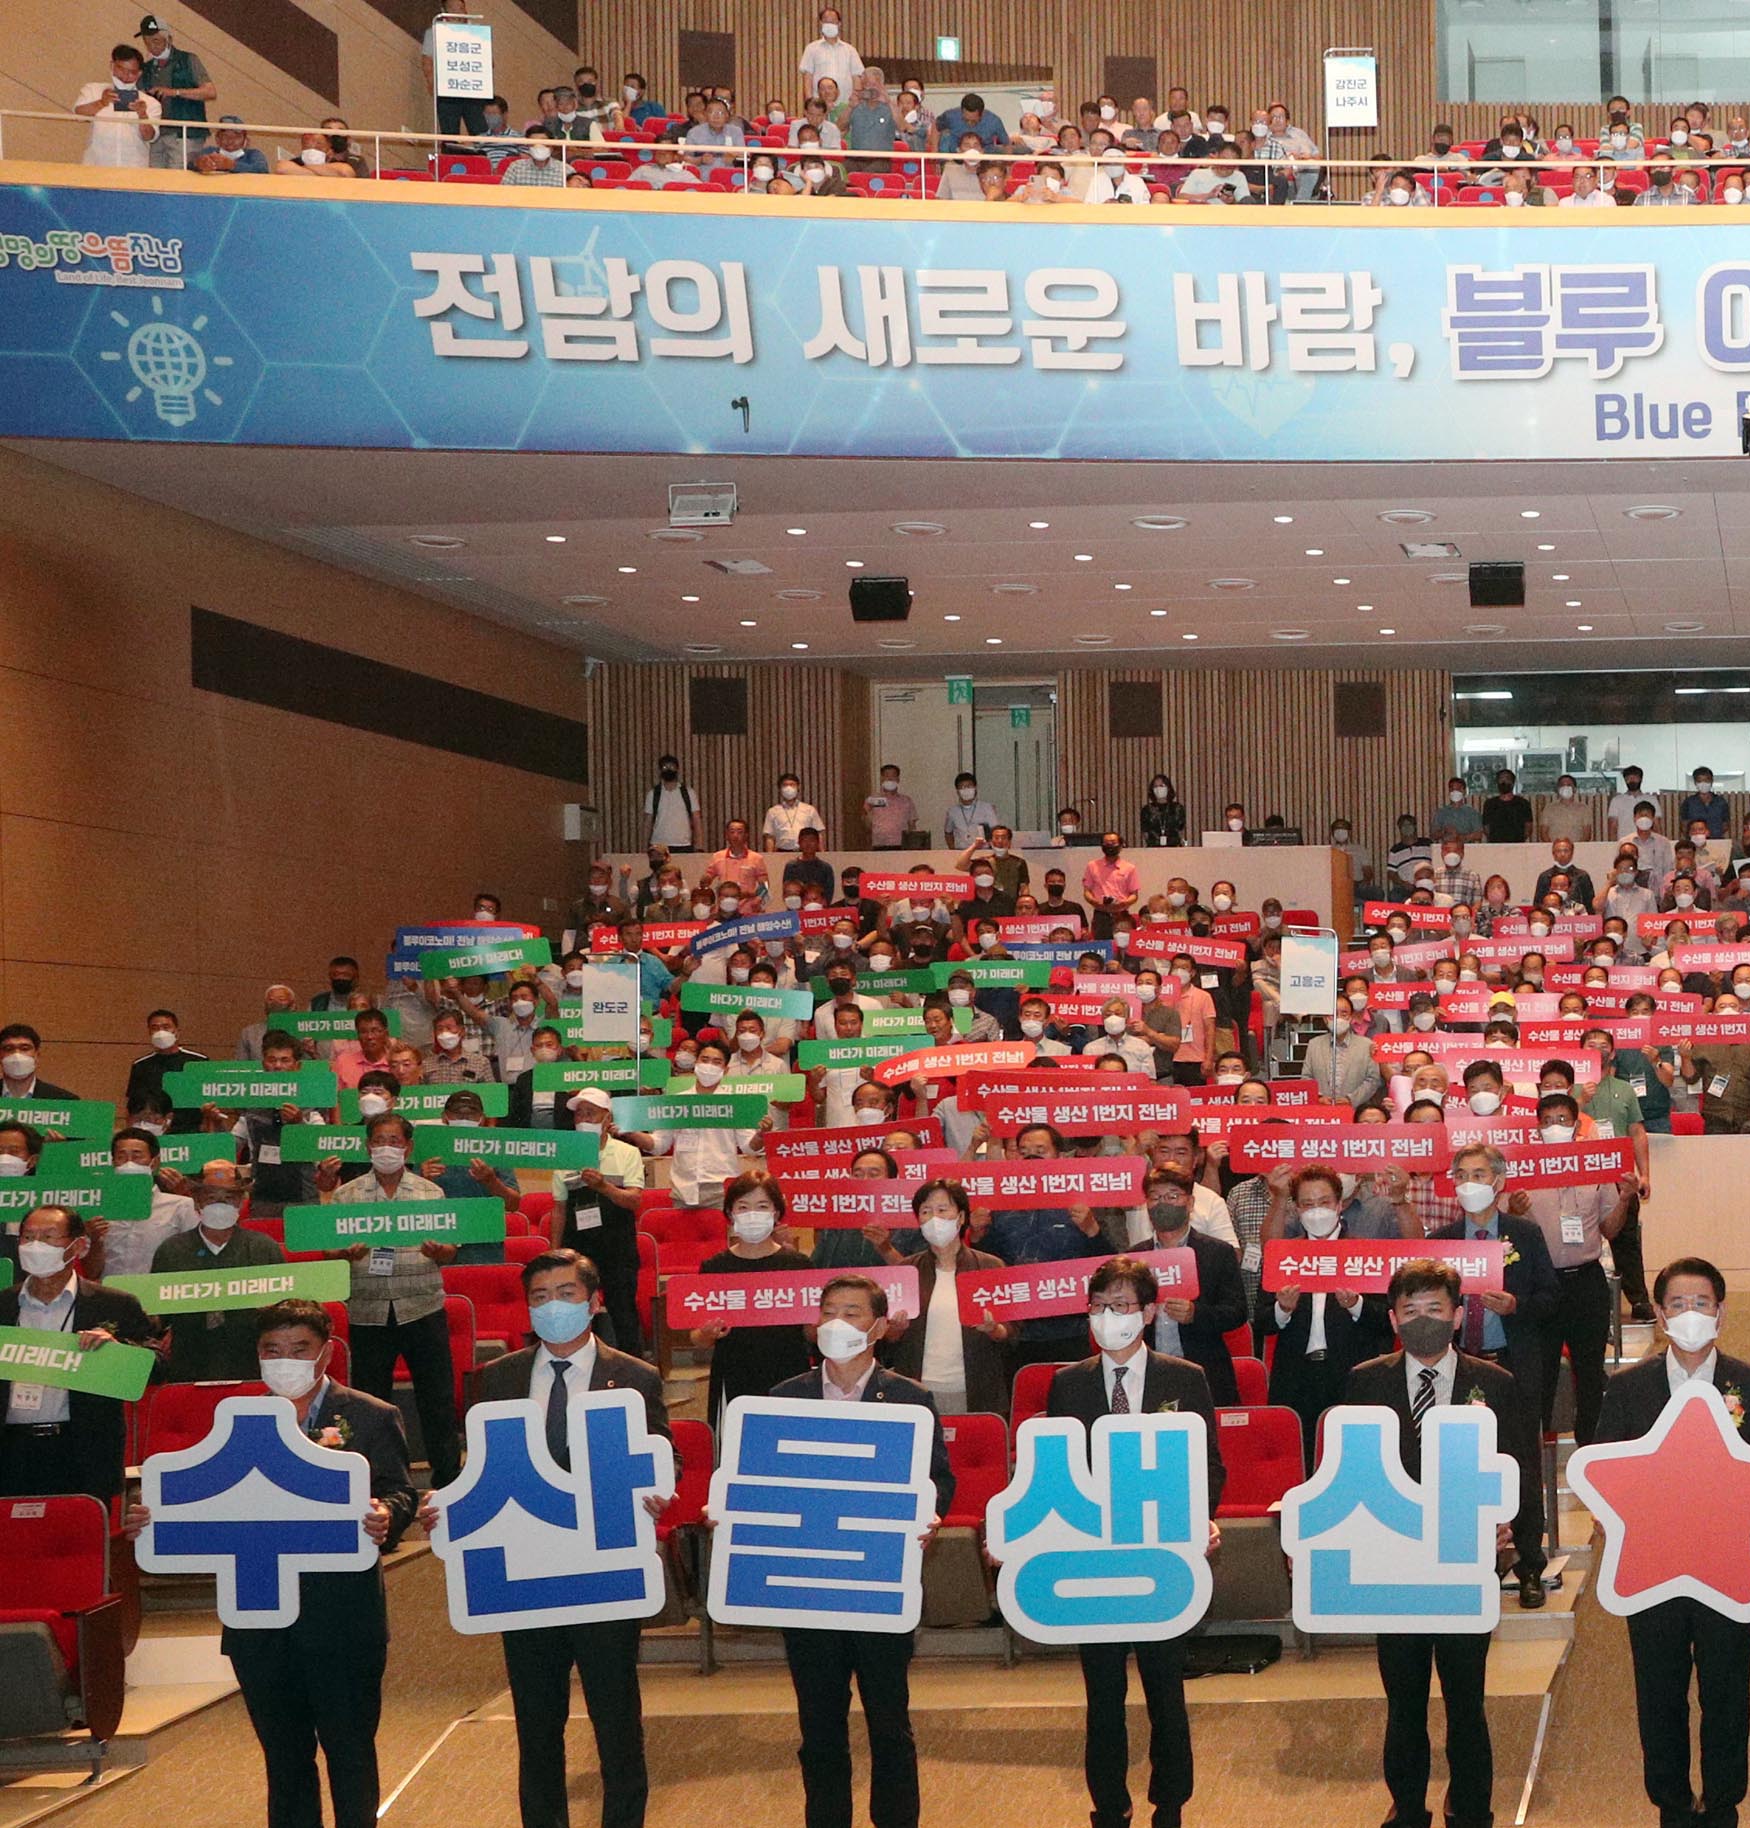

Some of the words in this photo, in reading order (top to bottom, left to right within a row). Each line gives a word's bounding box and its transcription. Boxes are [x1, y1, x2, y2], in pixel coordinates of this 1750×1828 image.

[447, 61, 483, 72] 보성군
[1336, 96, 1368, 107] 나주시
[410, 252, 754, 364] 전남의
[805, 265, 1126, 371] 새로운
[1175, 271, 1414, 379] 바람,
[1448, 269, 1659, 374] 블루
[1596, 393, 1712, 442] Blue
[756, 918, 792, 933] 해양수산!
[448, 953, 484, 969] 바다가
[486, 949, 523, 965] 미래다!
[1135, 938, 1160, 952] 수산물
[1214, 946, 1236, 960] 전남!
[1290, 975, 1325, 988] 고흥군
[593, 1001, 629, 1015] 완도군
[710, 992, 742, 1006] 바다가
[746, 995, 782, 1009] 미래다!
[882, 1059, 920, 1079] 수산물
[924, 1054, 951, 1068] 생산
[955, 1051, 988, 1066] 1번지
[992, 1050, 1024, 1064] 전남!
[998, 1108, 1047, 1124] 수산물
[1053, 1105, 1088, 1122] 생산
[1092, 1104, 1133, 1122] 1번지
[1138, 1104, 1178, 1120] 전남!
[455, 1139, 500, 1154] 바다가
[505, 1142, 556, 1157] 미래다!
[1243, 1140, 1295, 1158] 수산물
[1301, 1139, 1337, 1158] 생산
[1342, 1140, 1385, 1158] 1번지
[1391, 1139, 1433, 1157] 전남!
[1538, 1156, 1578, 1176] 1번지
[1584, 1153, 1621, 1171] 전남!
[1001, 1176, 1036, 1193] 생산
[1041, 1175, 1084, 1193] 1번지
[1090, 1172, 1132, 1190] 전남!
[792, 1195, 827, 1212] 생산
[831, 1193, 875, 1212] 1번지
[337, 1217, 392, 1234] 바다가
[398, 1214, 456, 1232] 미래다!
[1279, 1257, 1337, 1277] 수산물
[1344, 1256, 1383, 1276] 생산
[160, 1284, 221, 1300] 바다가
[228, 1276, 295, 1295] 미래다!
[972, 1282, 1030, 1307] 수산물
[1037, 1277, 1076, 1300] 생산
[684, 1291, 746, 1311] 수산물
[753, 1288, 795, 1308] 생산
[153, 1414, 359, 1611] 수
[447, 1406, 656, 1617] 산
[725, 1413, 917, 1616] 물
[1004, 1428, 1195, 1627] 생
[1298, 1422, 1503, 1616] 산
